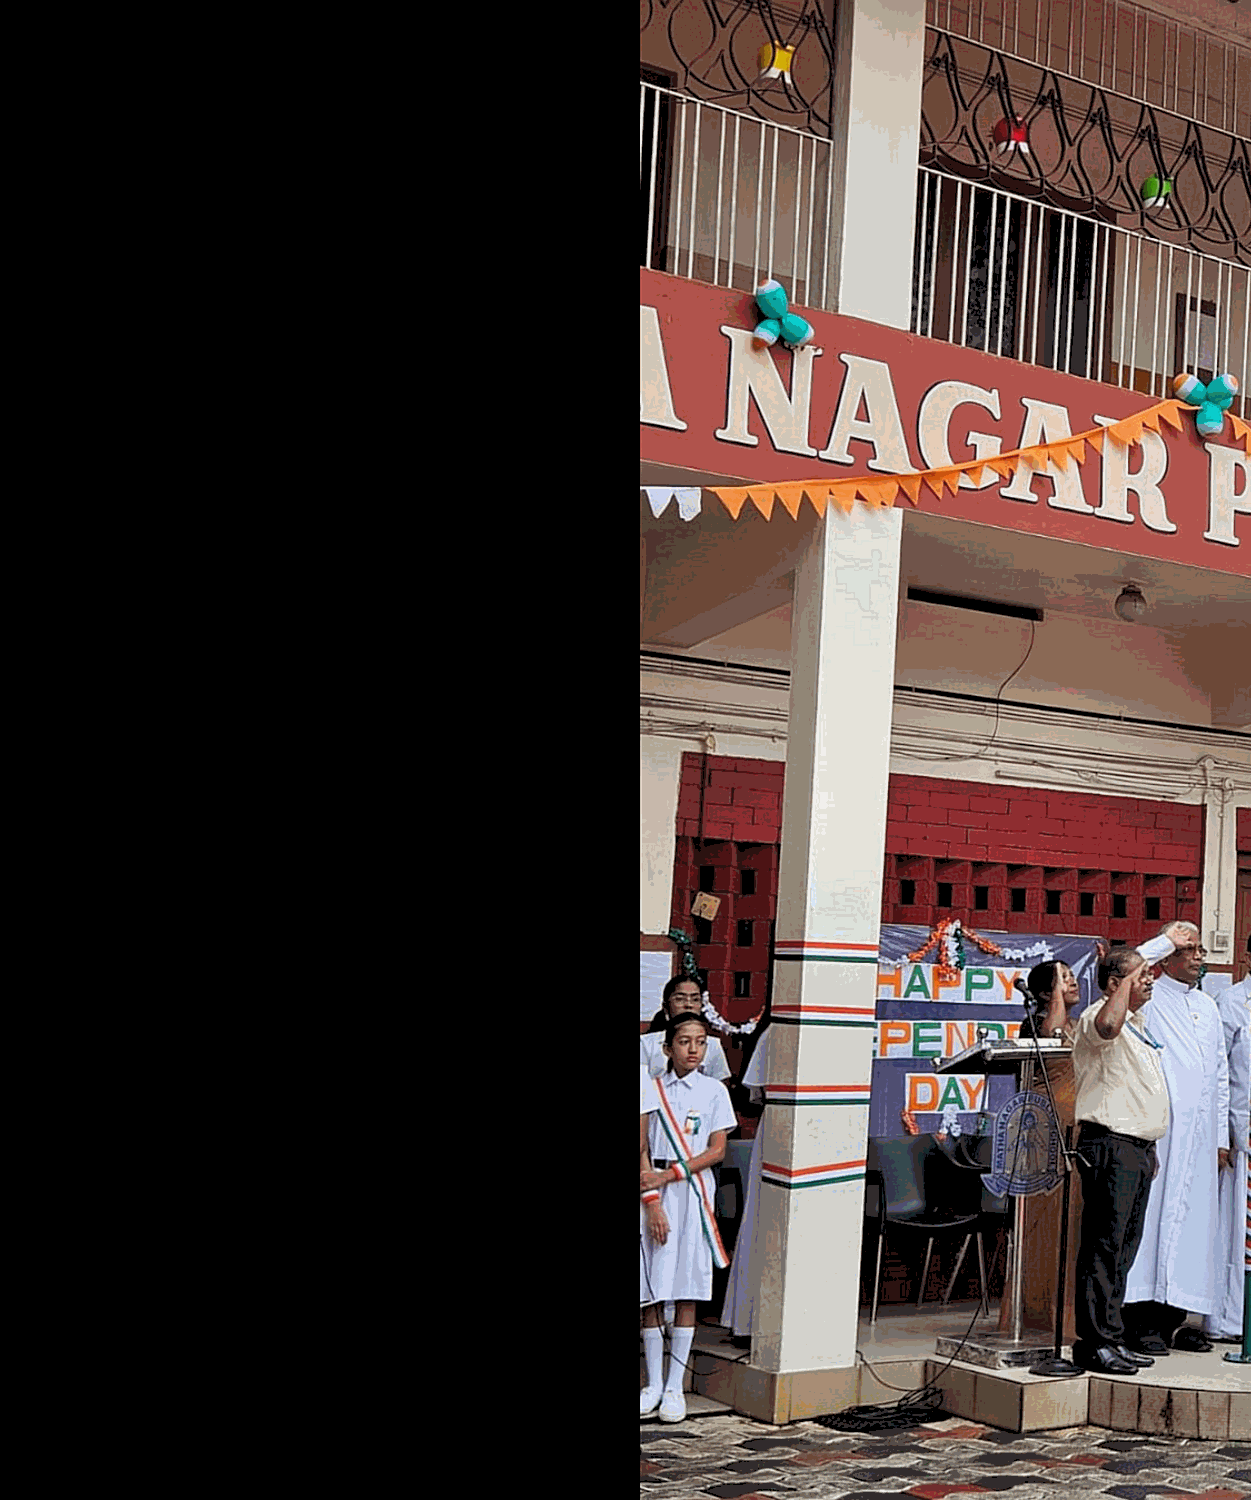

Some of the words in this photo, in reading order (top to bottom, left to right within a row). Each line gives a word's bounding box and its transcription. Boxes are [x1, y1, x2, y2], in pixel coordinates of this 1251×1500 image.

[714, 324, 1178, 533] NAGAR
[877, 964, 1021, 1001] HAPPY
[909, 1075, 985, 1112] DAY
